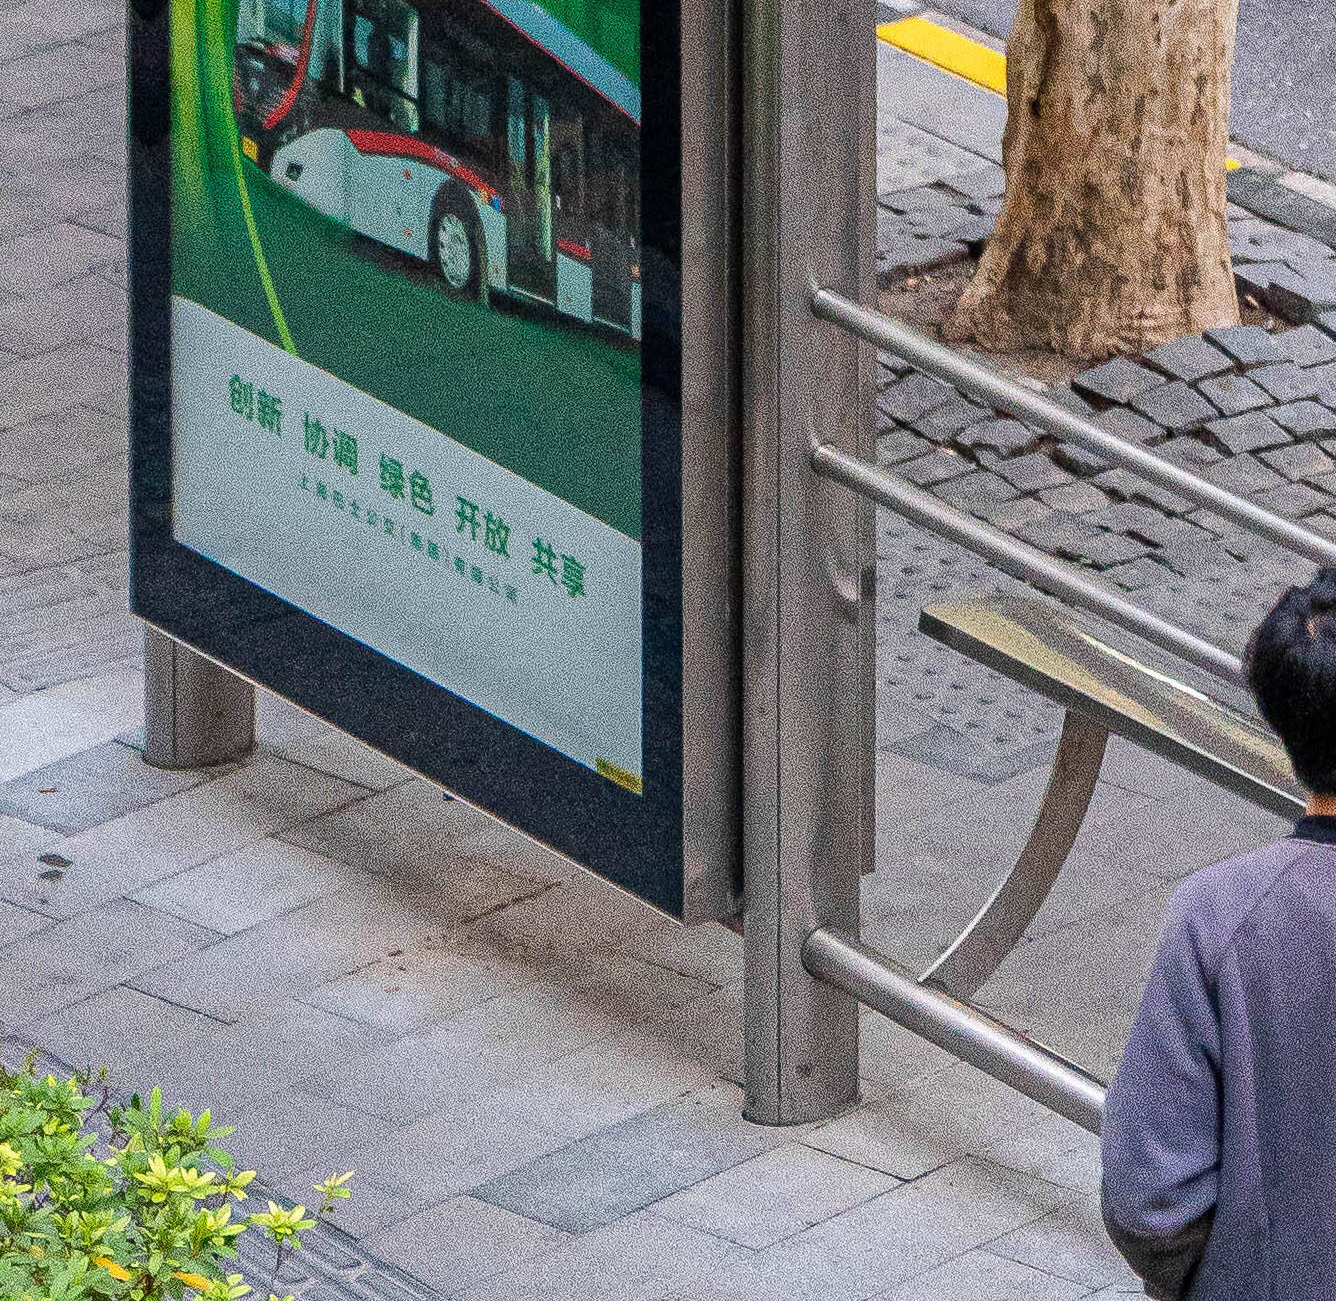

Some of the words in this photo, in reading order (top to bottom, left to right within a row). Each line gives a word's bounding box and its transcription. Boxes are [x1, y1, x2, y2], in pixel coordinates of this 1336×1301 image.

[228, 374, 283, 437] 创新
[302, 411, 359, 476] 协调
[378, 453, 436, 517] 绿色
[454, 495, 510, 560] 开放
[530, 537, 587, 599] 共享
